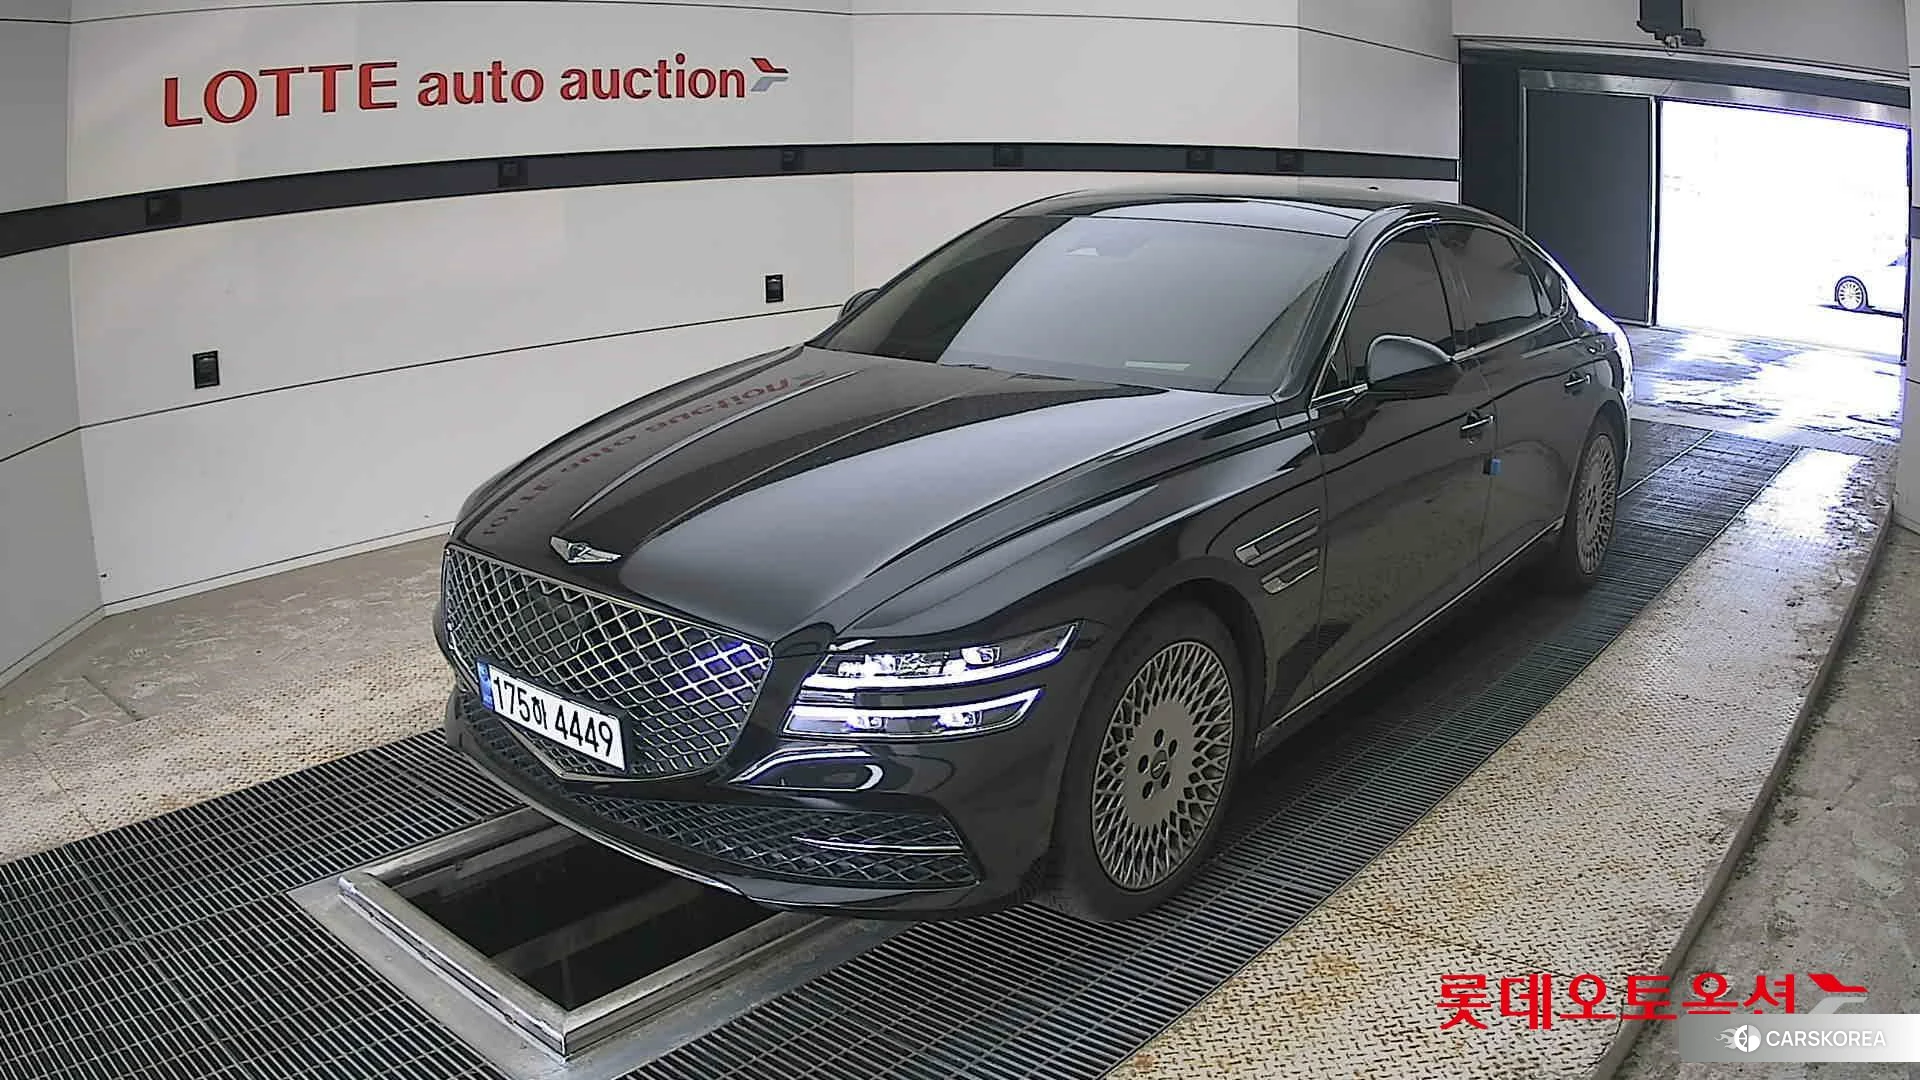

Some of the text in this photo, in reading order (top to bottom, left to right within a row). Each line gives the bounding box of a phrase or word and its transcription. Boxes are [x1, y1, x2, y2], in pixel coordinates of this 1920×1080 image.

[164, 52, 746, 127] LOTTE auto auction
[554, 704, 614, 757] 4449
